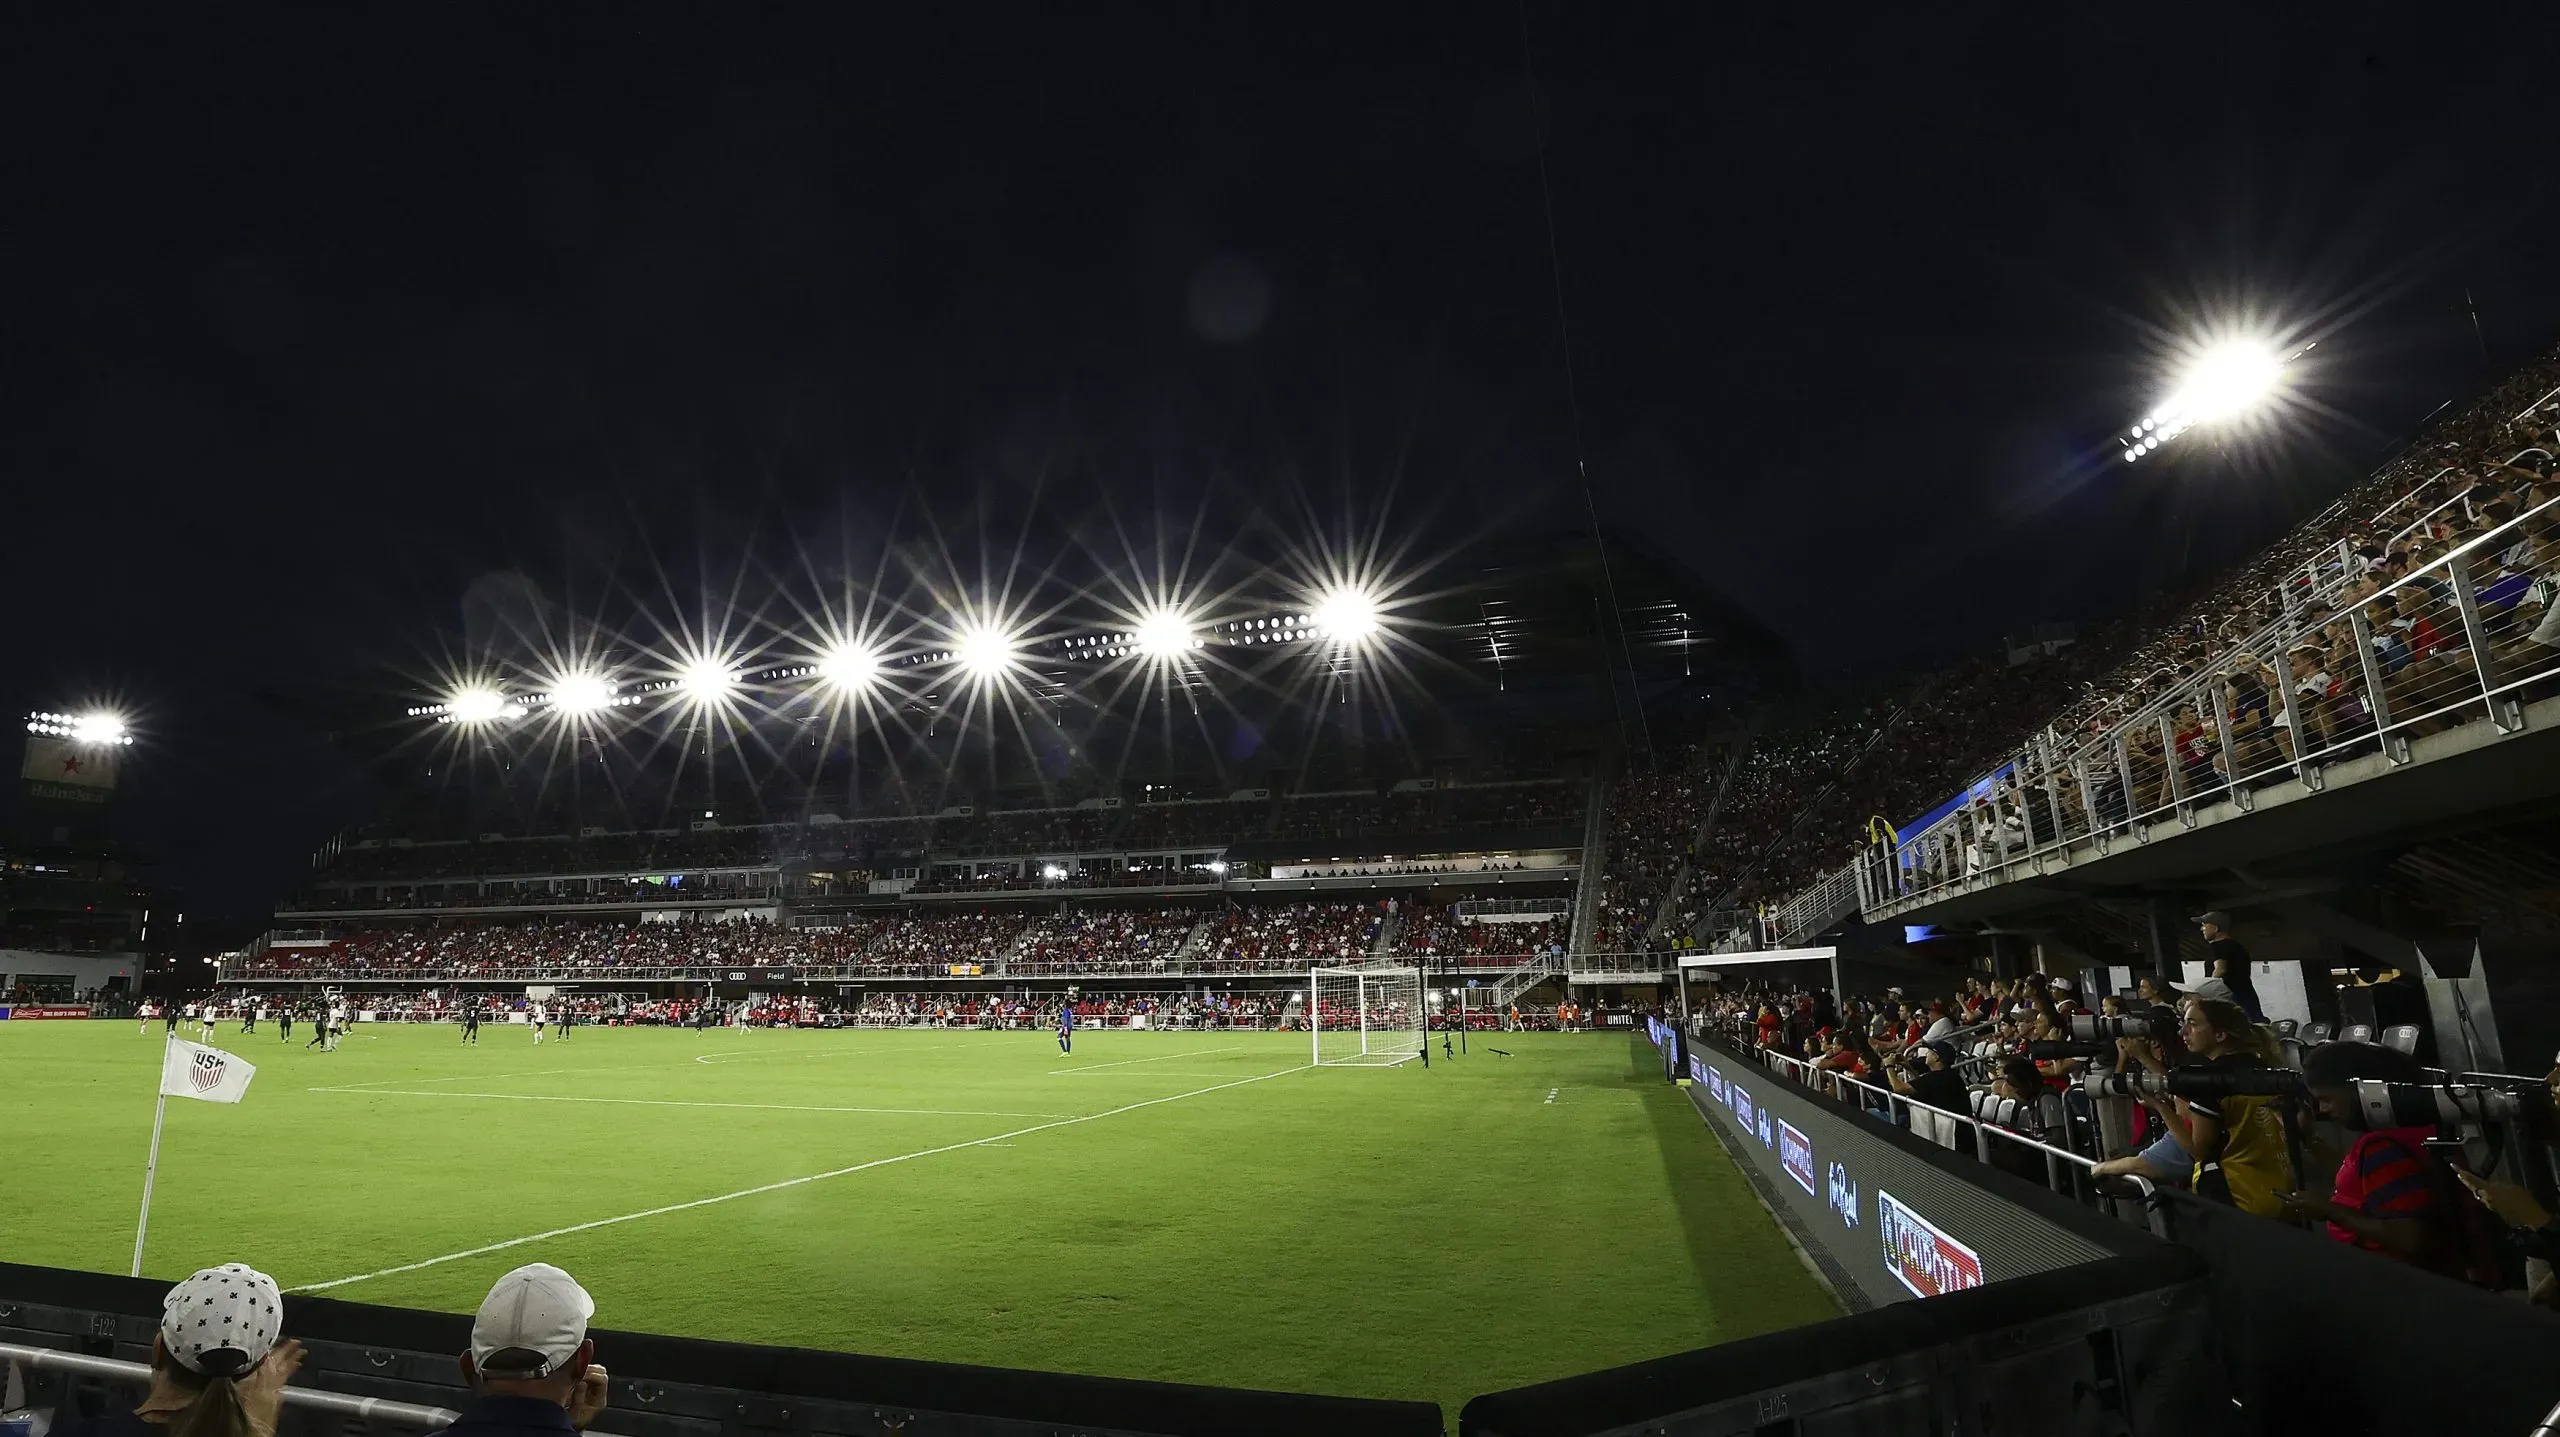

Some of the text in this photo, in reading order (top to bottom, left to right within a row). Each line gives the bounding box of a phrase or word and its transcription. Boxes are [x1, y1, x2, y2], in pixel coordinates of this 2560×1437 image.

[31, 783, 104, 803] Heineken
[767, 972, 785, 980] Field
[470, 1010, 475, 1018] 5
